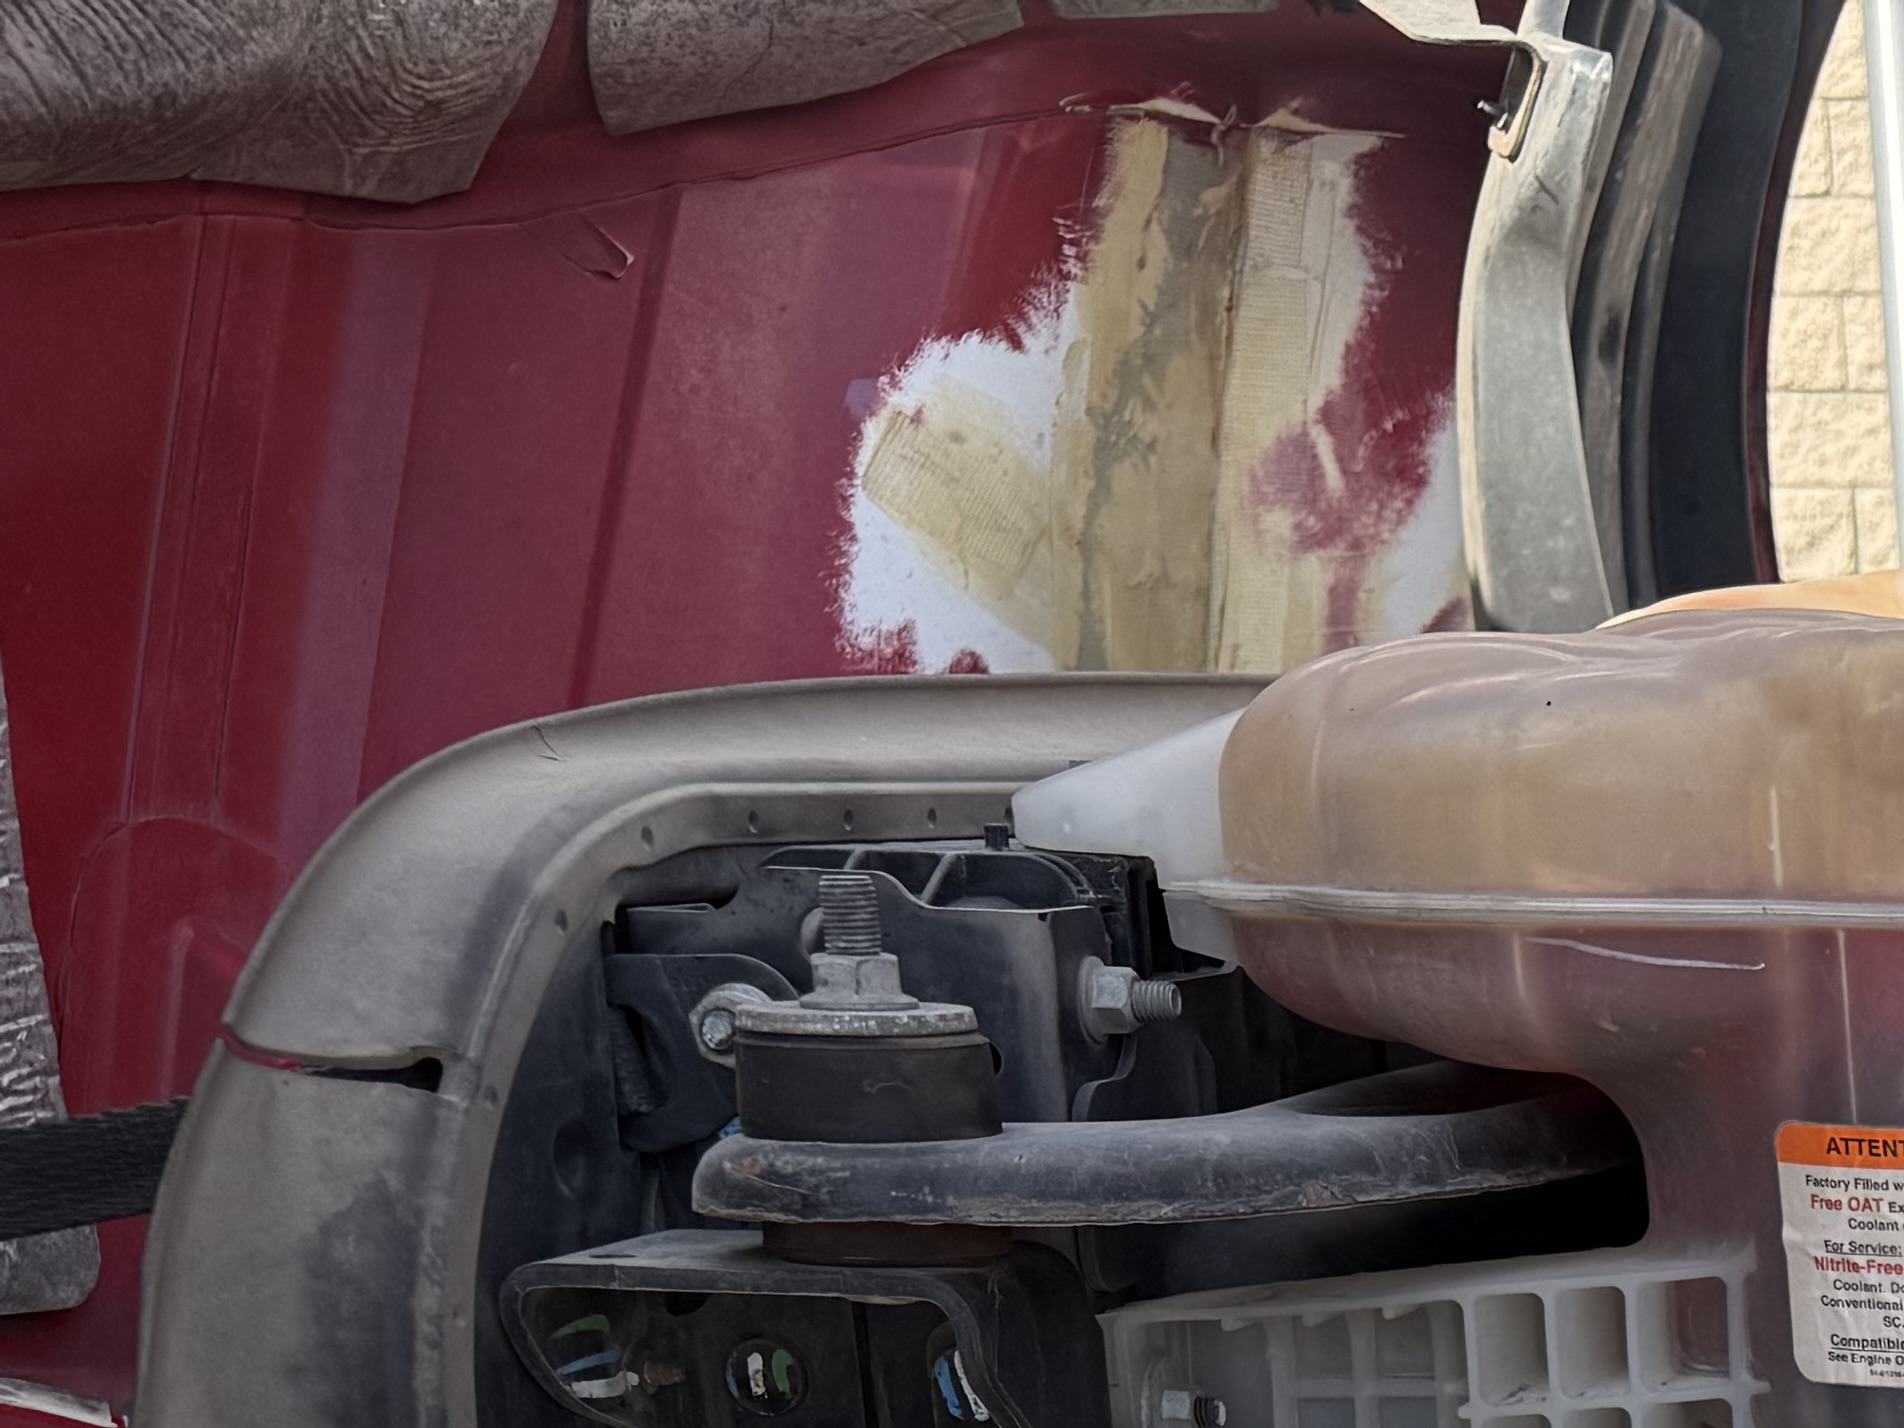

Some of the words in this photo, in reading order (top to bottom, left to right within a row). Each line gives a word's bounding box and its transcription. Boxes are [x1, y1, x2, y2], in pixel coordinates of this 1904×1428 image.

[1805, 1174, 1850, 1192] Factory
[1854, 1178, 1889, 1191] Filled
[1810, 1194, 1842, 1211] Free
[1847, 1196, 1884, 1213] OAT
[1848, 1218, 1899, 1232] Coolant
[1824, 1239, 1844, 1254] For
[1848, 1241, 1902, 1256] Service:
[1814, 1256, 1904, 1275] Nitrite-Free
[1833, 1279, 1885, 1293] Coolant.
[1820, 1295, 1903, 1311] Conventional
[1828, 1351, 1848, 1363] See
[1851, 1353, 1892, 1368] Engine
